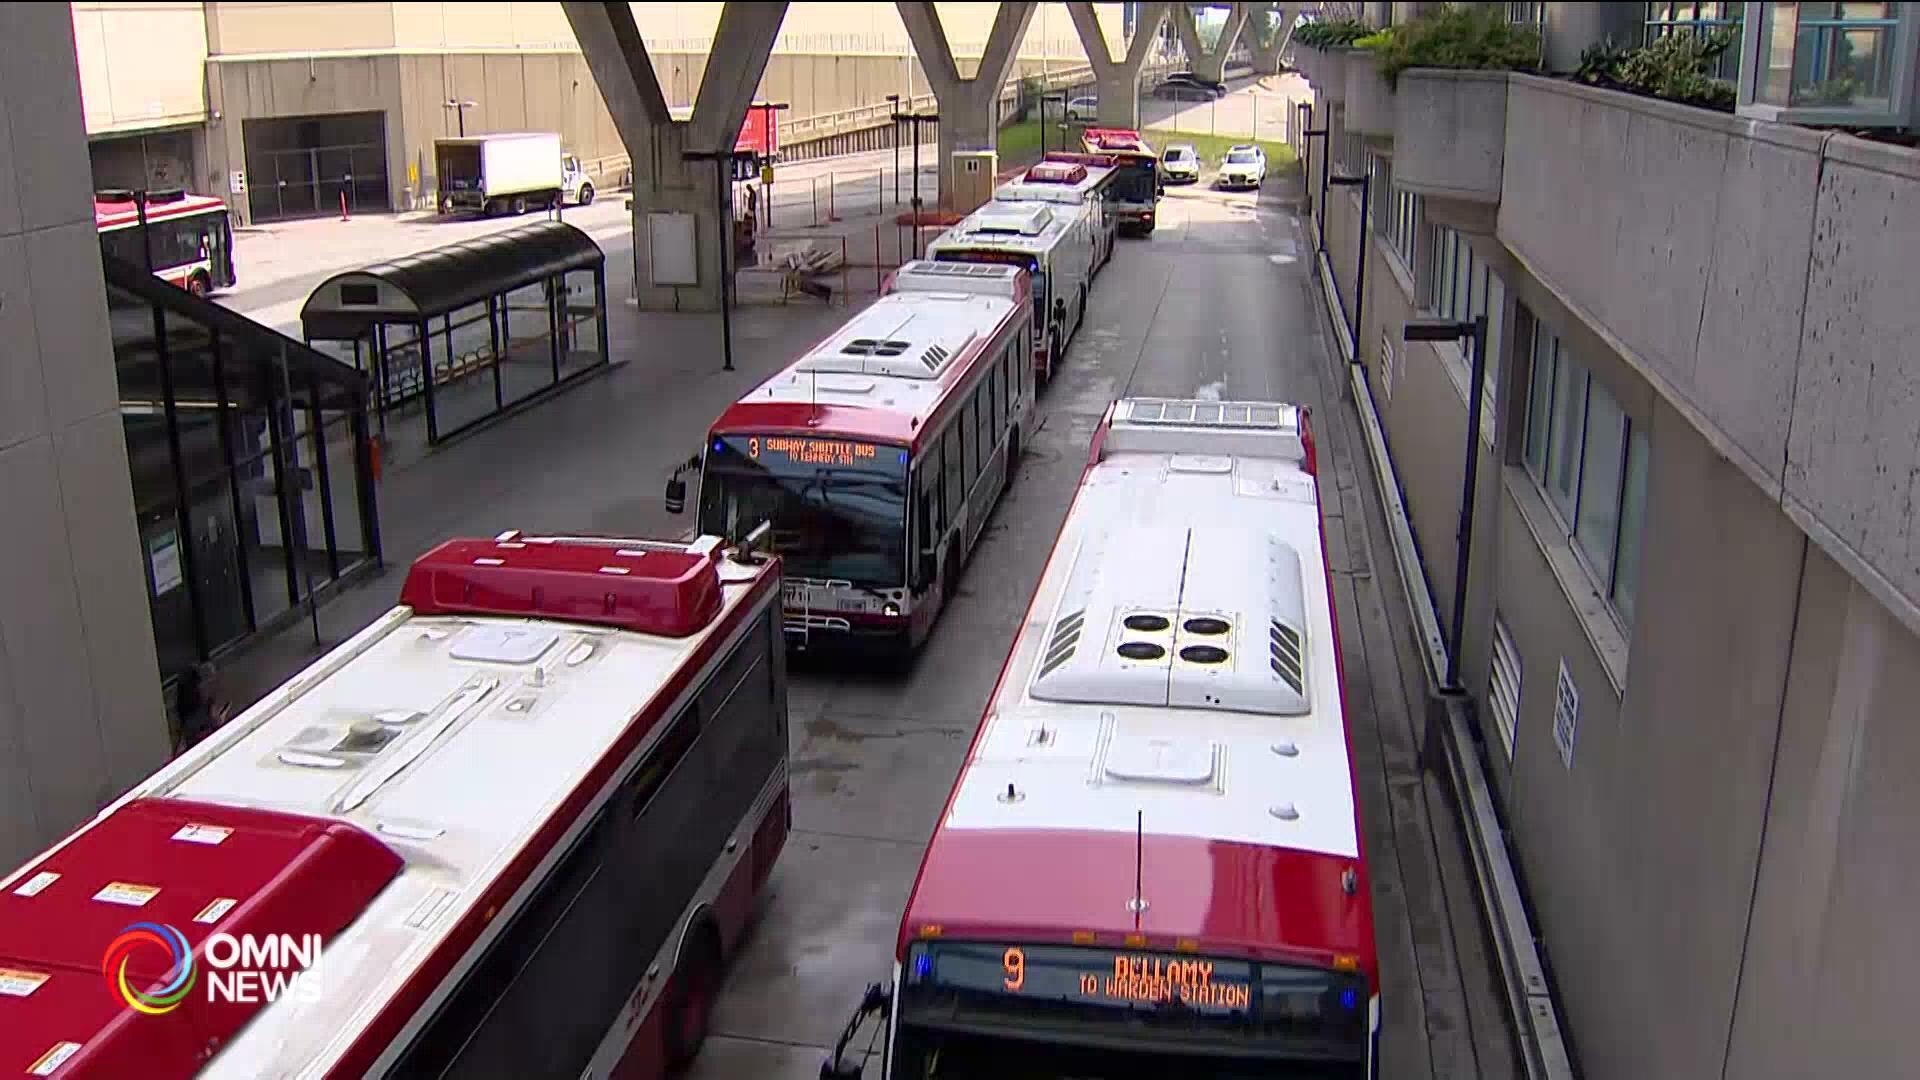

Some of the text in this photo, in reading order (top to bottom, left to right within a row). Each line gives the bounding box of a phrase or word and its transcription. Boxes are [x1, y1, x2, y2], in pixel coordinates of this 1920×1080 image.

[749, 438, 875, 458] 3 SUBWAY SHUTTLE BUS
[1003, 947, 1213, 991] 9 BELLAMY
[1080, 973, 1248, 1008] TO WARDEN STATION
